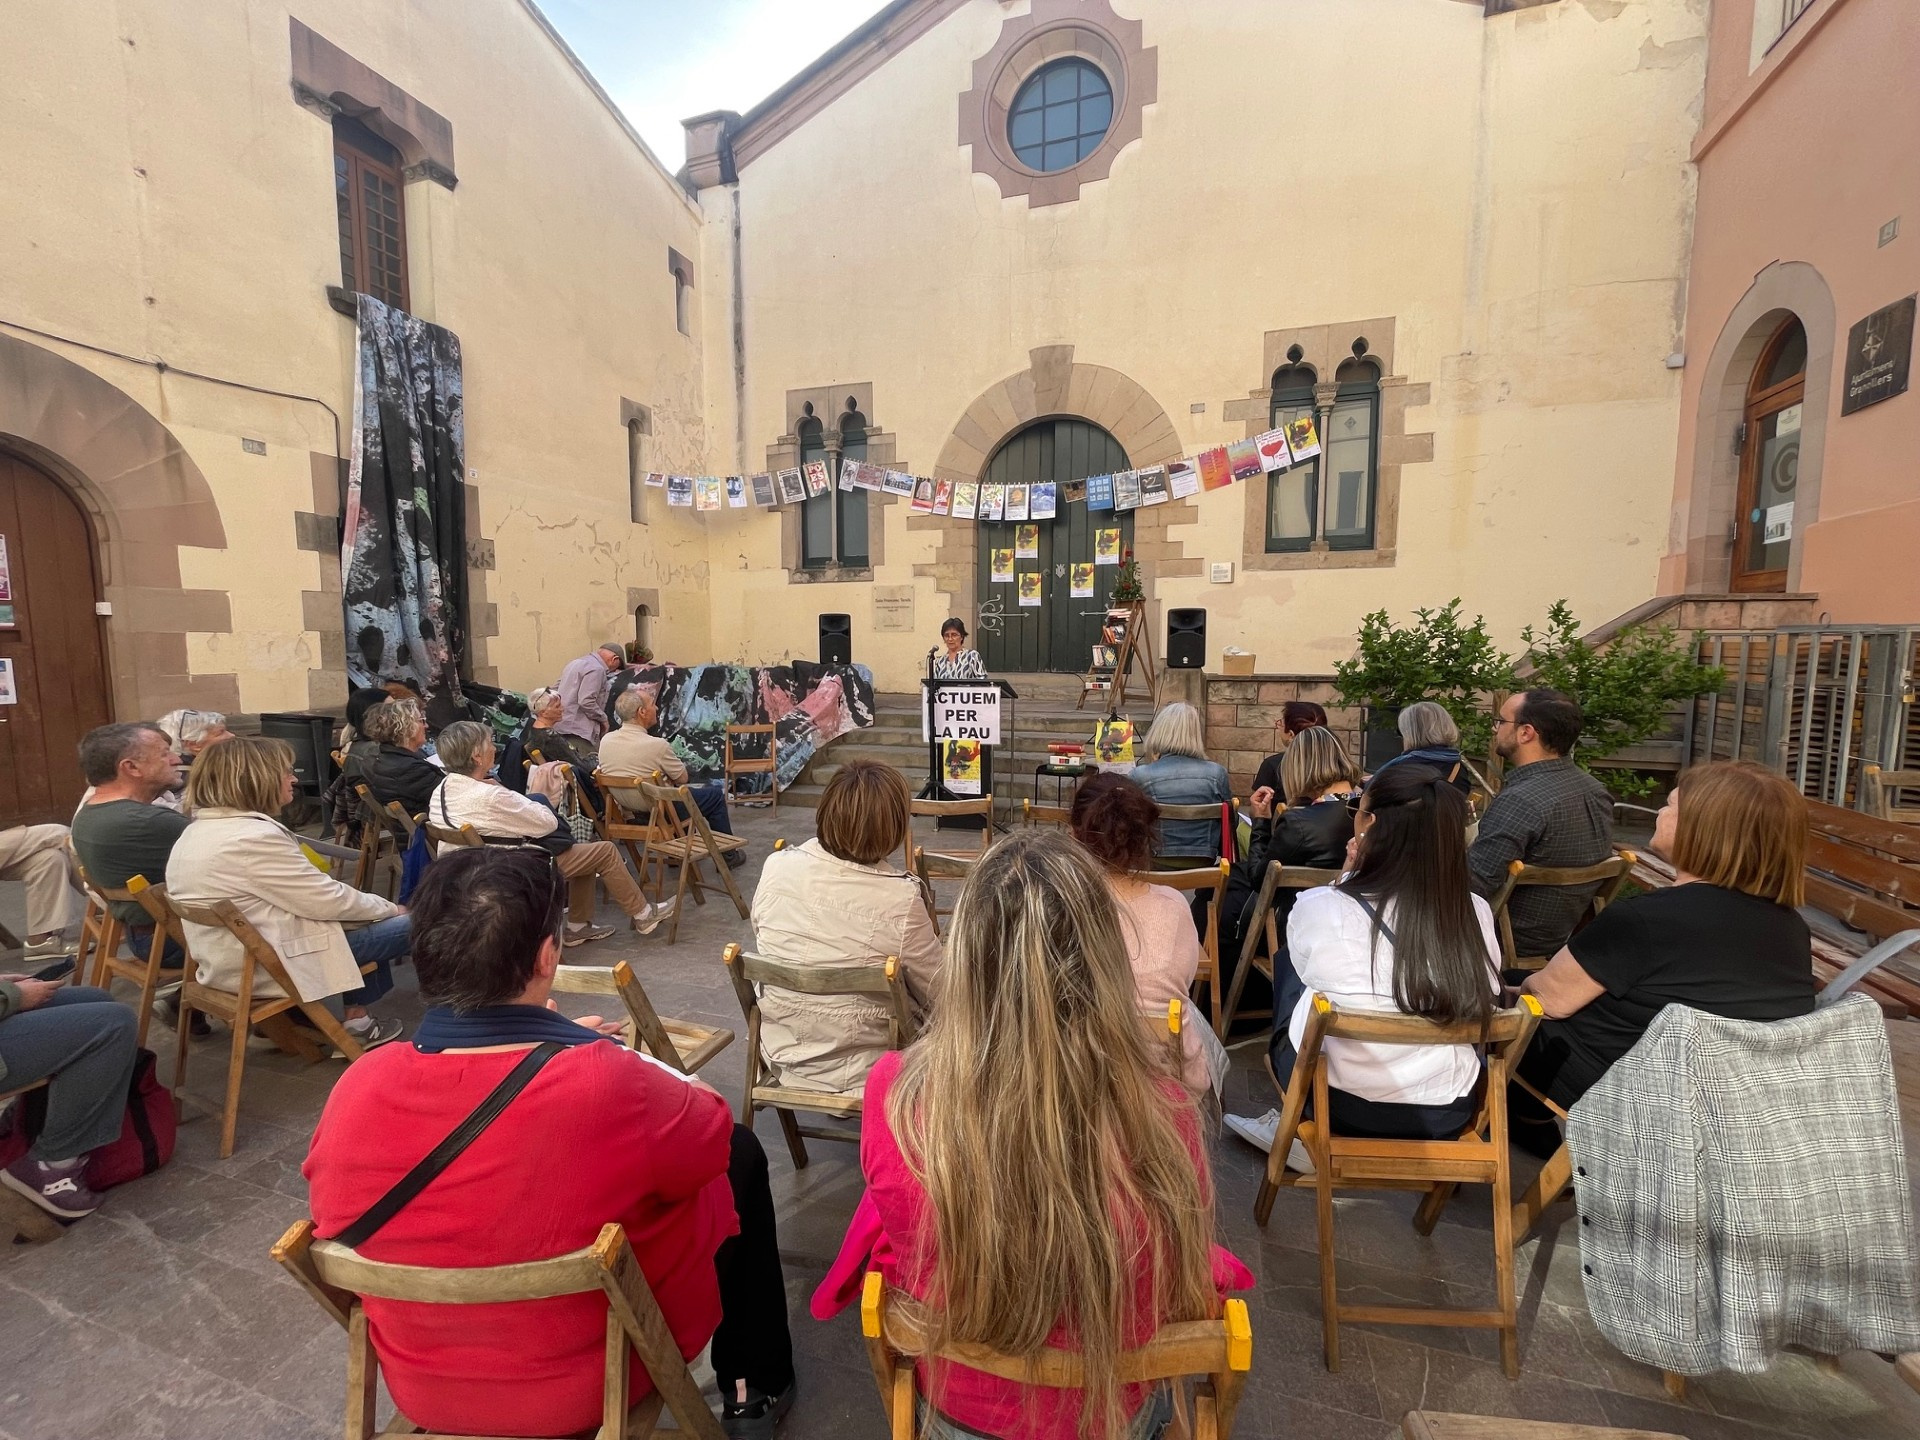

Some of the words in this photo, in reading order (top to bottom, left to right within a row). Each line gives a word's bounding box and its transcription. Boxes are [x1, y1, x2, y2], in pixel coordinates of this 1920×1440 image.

[1850, 373, 1892, 397] Granollers
[807, 464, 822, 474] PO
[809, 472, 825, 482] ES
[812, 481, 827, 490] IA
[945, 709, 977, 721] PER
[959, 727, 990, 739] PAU
